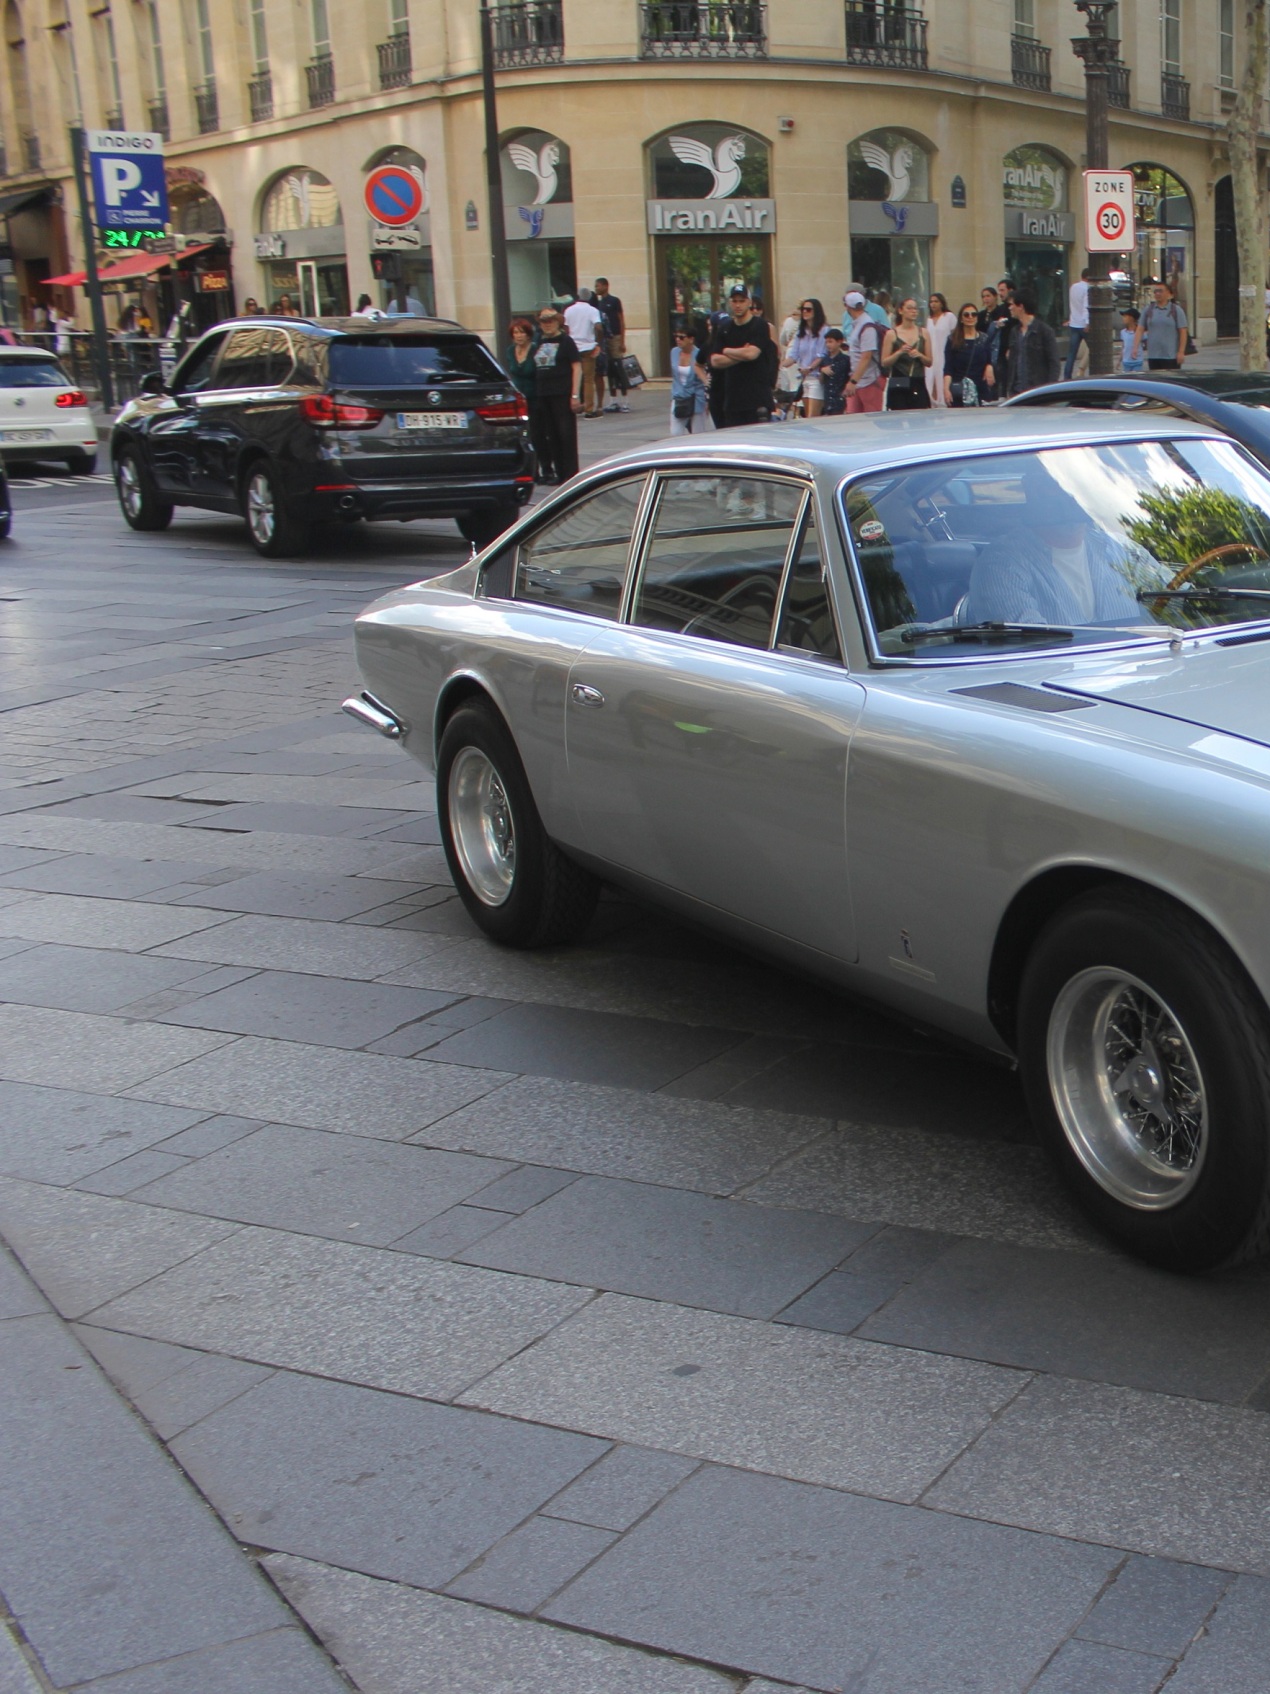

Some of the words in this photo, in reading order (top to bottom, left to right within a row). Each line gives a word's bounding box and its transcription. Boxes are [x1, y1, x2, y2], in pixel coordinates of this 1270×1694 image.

[97, 135, 154, 149] INDIGO
[100, 157, 142, 206] P
[1095, 182, 1125, 193] ZONE
[655, 202, 768, 230] IranAir
[1022, 212, 1066, 237] IranAir
[1102, 213, 1119, 229] 30
